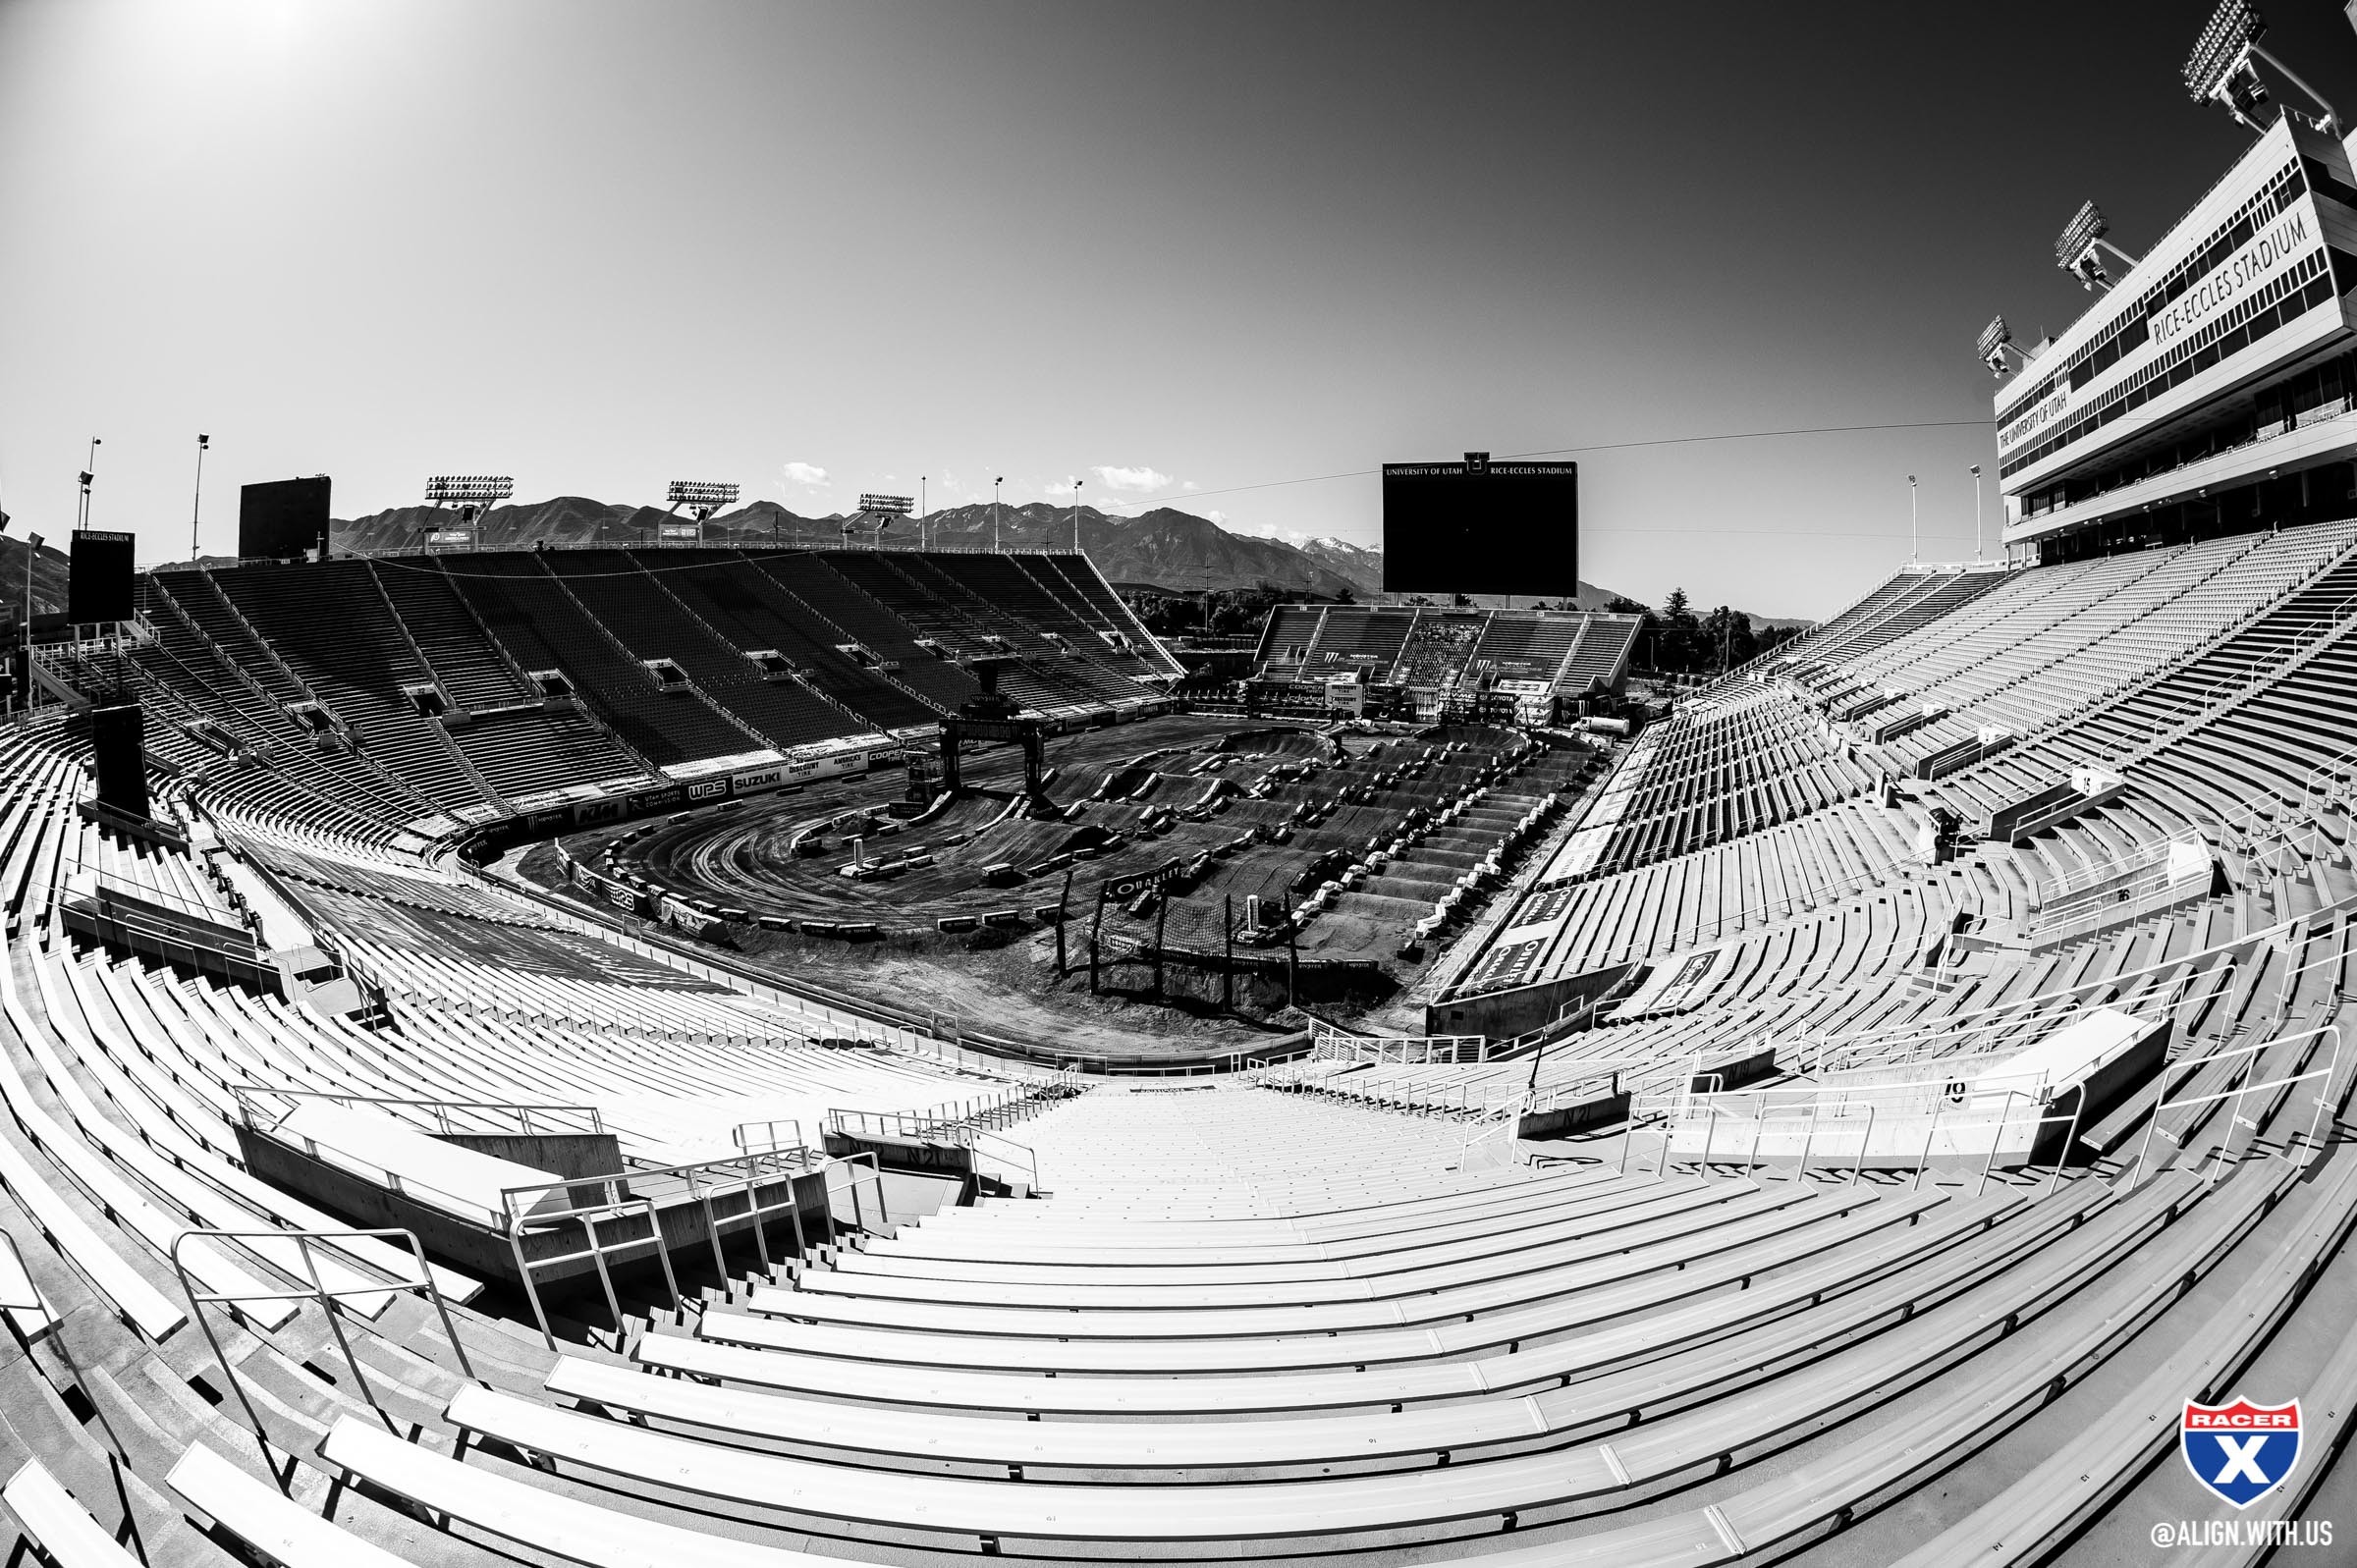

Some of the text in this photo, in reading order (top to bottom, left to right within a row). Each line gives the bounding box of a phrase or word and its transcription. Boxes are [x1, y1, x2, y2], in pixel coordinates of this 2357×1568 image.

[2154, 211, 2307, 346] RICE-ECCLES STADIUM
[2000, 391, 2067, 449] THE UNIVERSITY OF UTAH
[1490, 466, 1572, 475] RICE-ECCLES STADIUM
[734, 772, 781, 789] SUZUKI
[644, 789, 681, 802] UTAH SPORTS
[688, 780, 727, 801] WPS
[2117, 889, 2130, 902] 16
